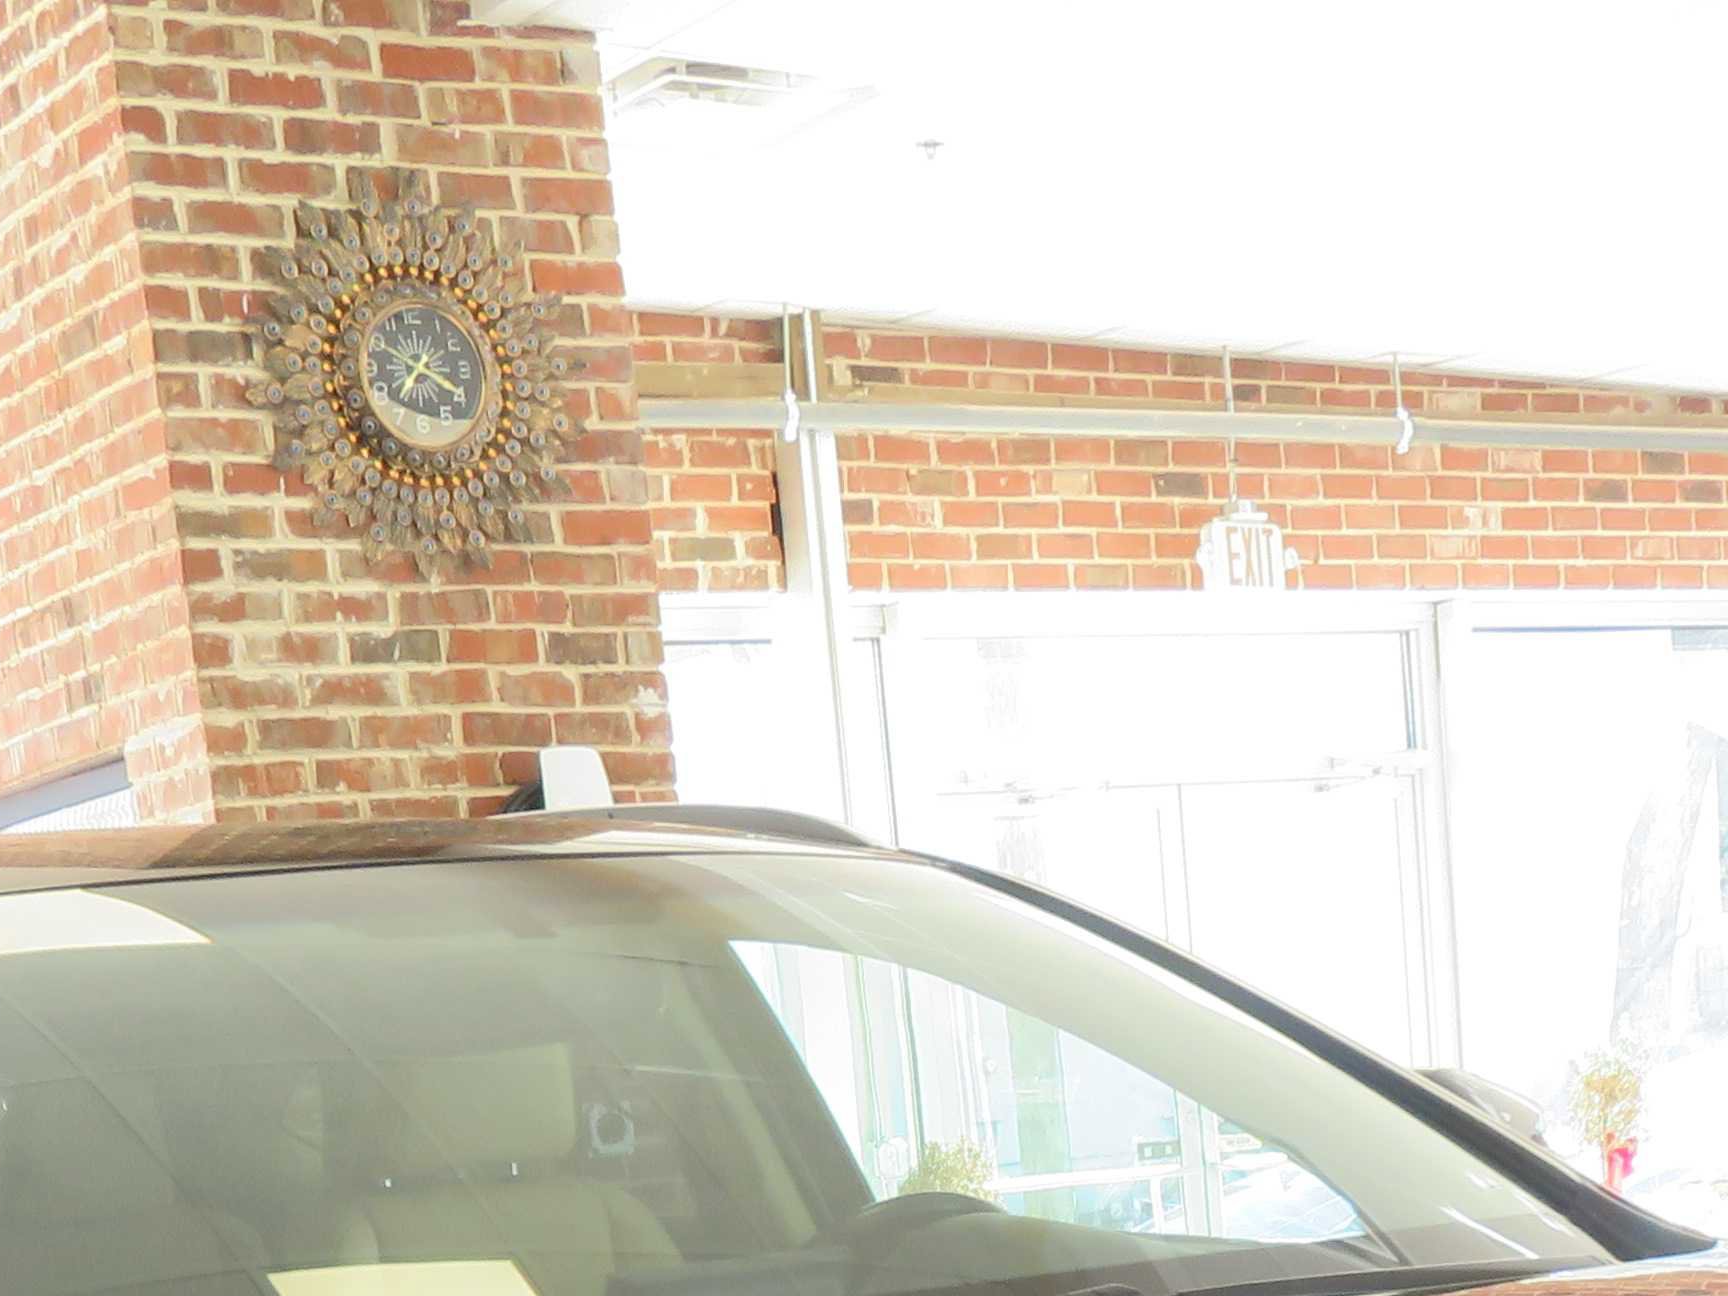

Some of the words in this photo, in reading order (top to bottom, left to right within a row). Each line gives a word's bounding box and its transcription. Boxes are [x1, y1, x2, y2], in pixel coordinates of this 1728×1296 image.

[392, 408, 406, 426] 7
[416, 414, 431, 434] 6
[439, 405, 453, 426] 5
[1225, 526, 1274, 588] EXIT
